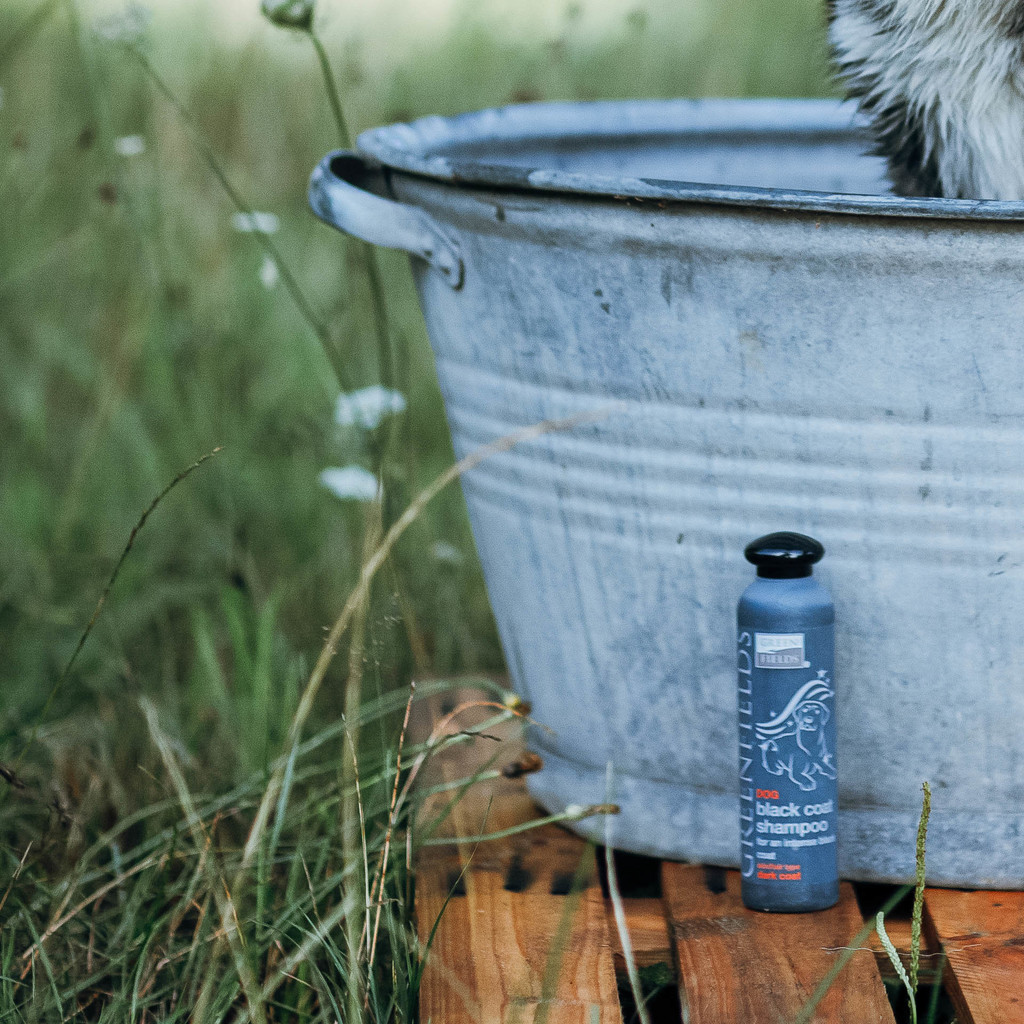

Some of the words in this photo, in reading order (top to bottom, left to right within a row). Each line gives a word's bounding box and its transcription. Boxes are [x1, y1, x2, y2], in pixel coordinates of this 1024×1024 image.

[757, 789, 779, 799] DOG
[756, 801, 800, 816] black
[804, 799, 833, 816] coat
[757, 820, 828, 837] shampoo
